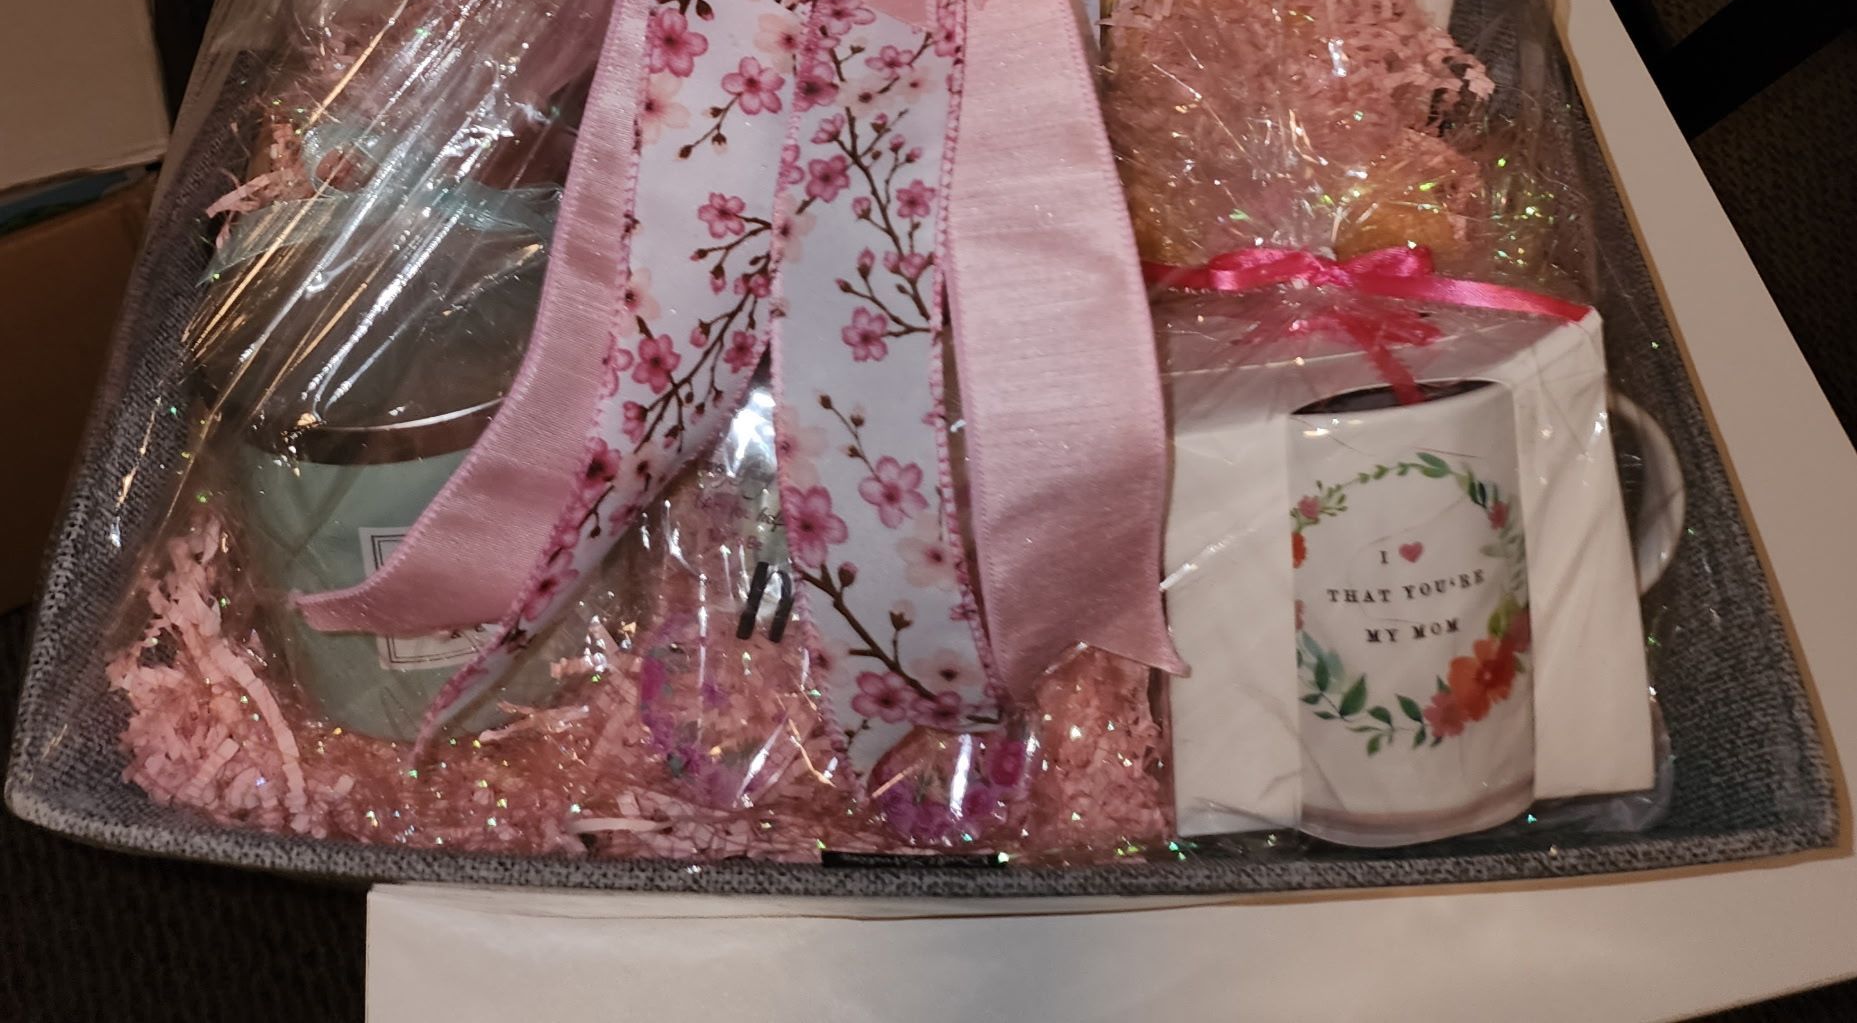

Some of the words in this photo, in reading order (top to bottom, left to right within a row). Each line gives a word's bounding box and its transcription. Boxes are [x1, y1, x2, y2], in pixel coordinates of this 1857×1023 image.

[1379, 550, 1389, 564] I
[1326, 588, 1393, 604] THAT
[1402, 569, 1486, 600] YOU'RE
[1366, 627, 1400, 643] MY
[1412, 617, 1461, 640] MOM
